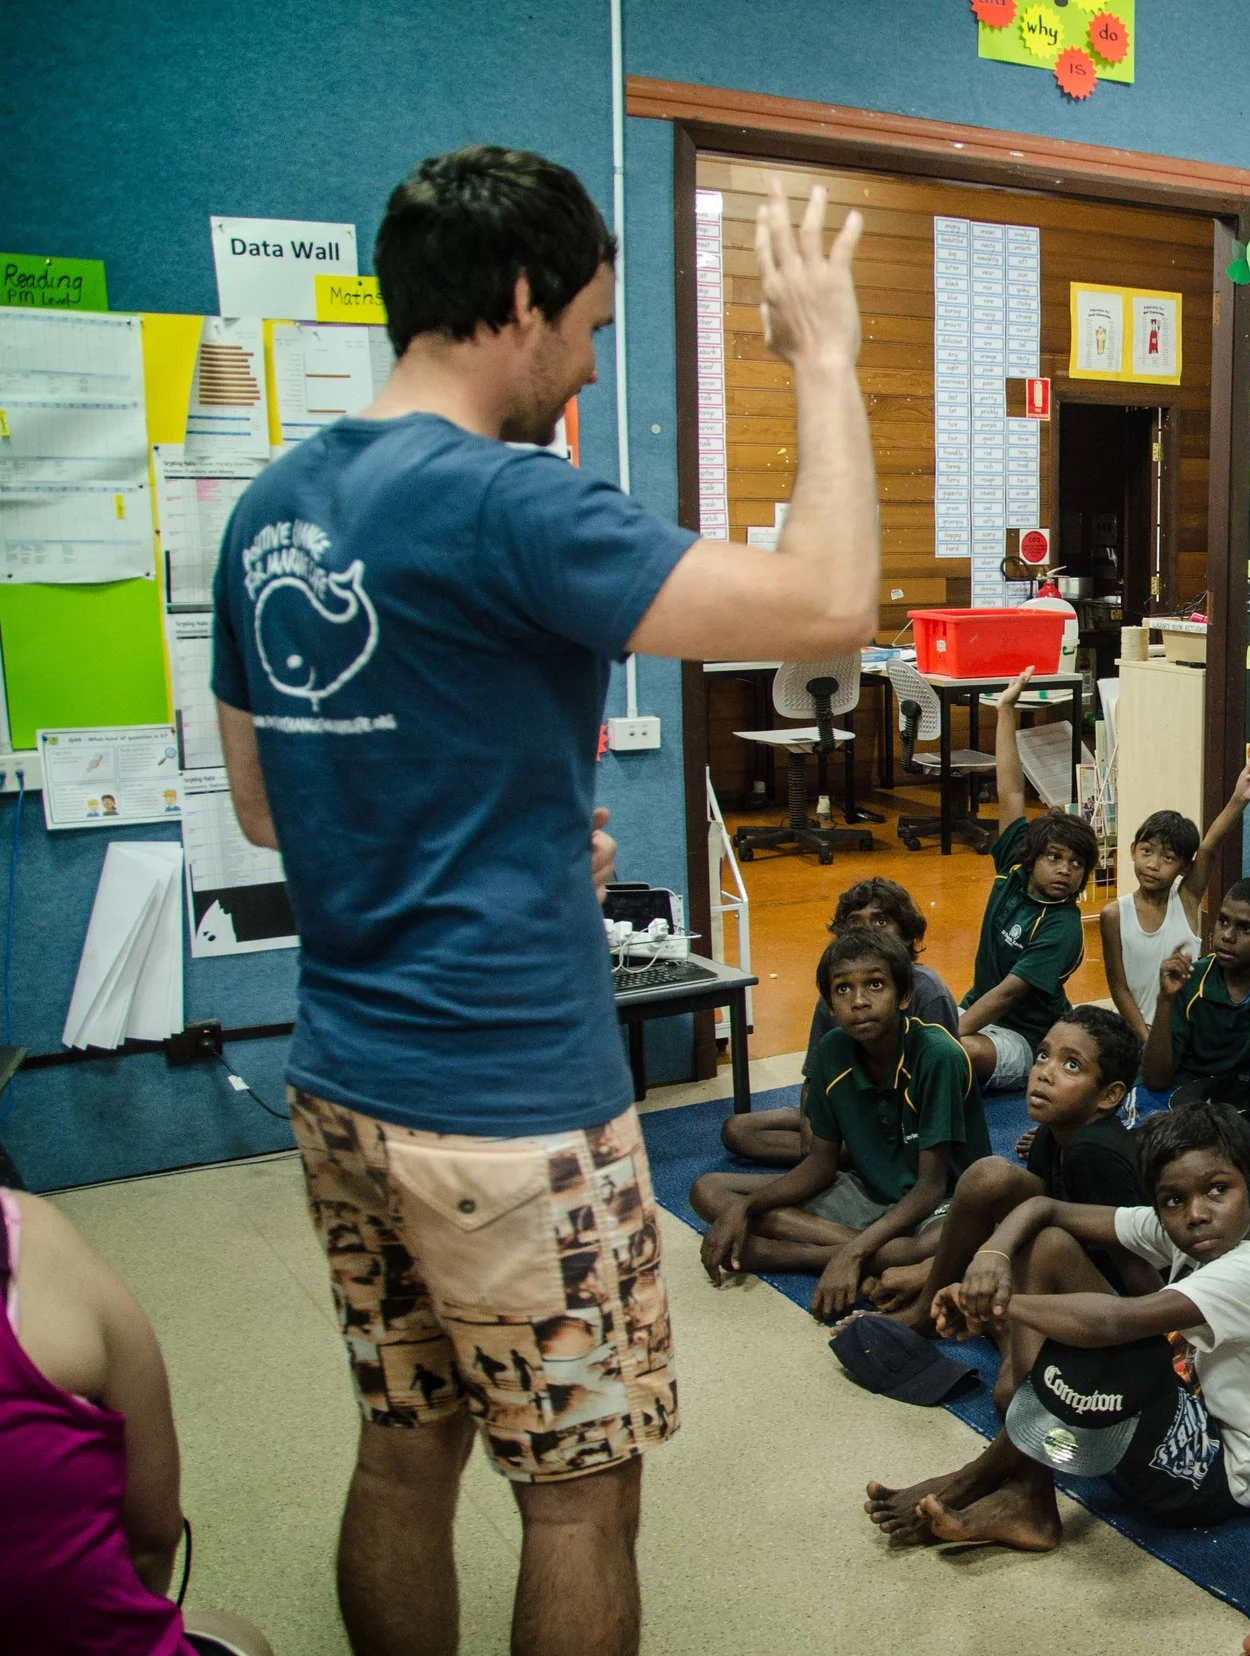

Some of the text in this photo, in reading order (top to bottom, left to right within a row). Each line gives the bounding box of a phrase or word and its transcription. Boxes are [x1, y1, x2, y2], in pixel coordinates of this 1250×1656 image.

[1027, 15, 1058, 46] why
[1098, 22, 1118, 42] do
[231, 238, 340, 261] Data Wall
[4, 264, 83, 304] Reading
[8, 289, 34, 304] PM
[330, 287, 384, 306] Maths
[1044, 1366, 1124, 1414] Compton
